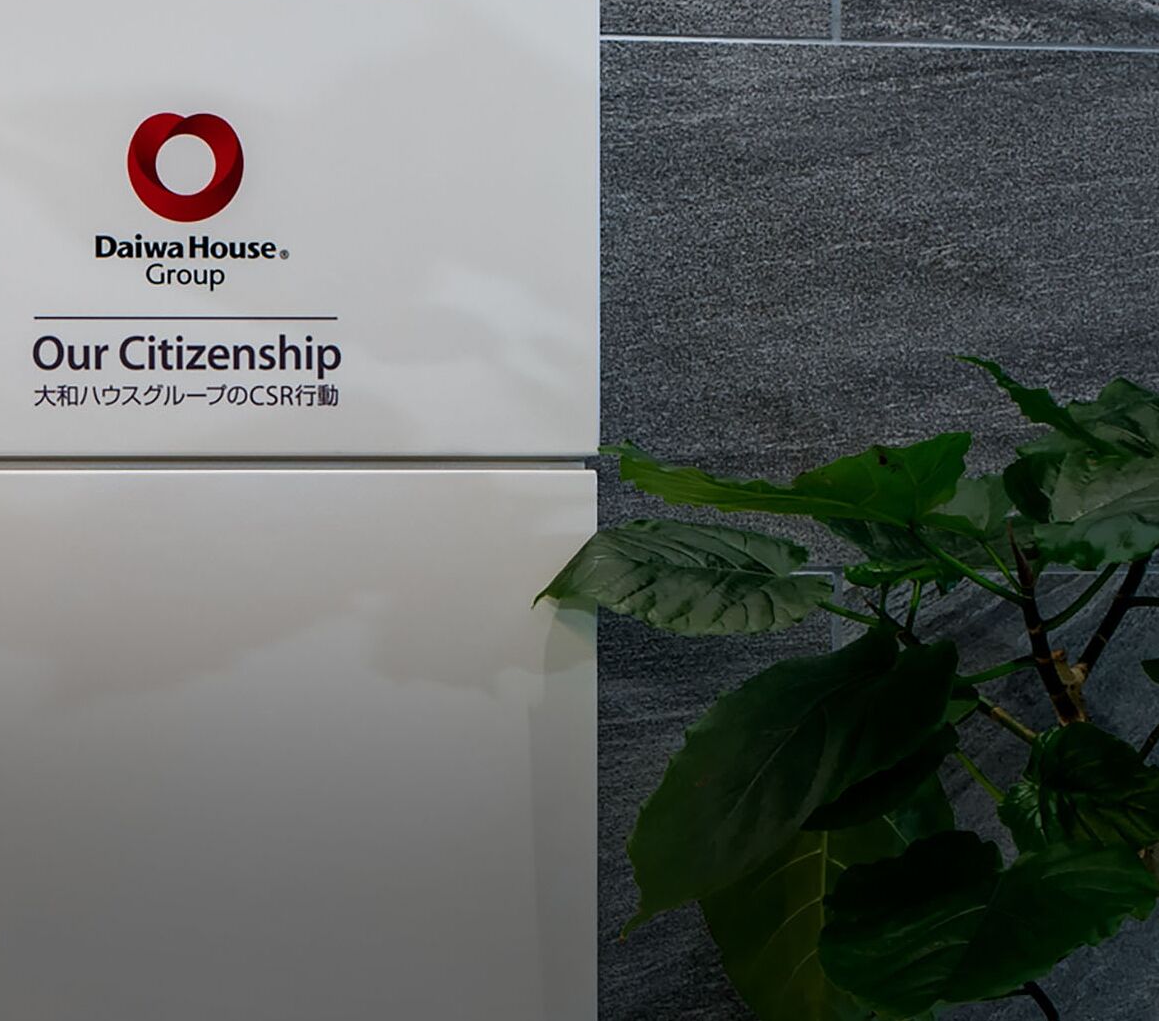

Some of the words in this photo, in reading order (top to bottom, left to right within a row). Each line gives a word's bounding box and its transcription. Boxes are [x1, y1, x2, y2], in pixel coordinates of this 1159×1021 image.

[95, 233, 183, 259] Daiwa
[145, 263, 225, 291] Group
[32, 335, 109, 371] Our
[119, 334, 342, 380] Citizenship
[33, 385, 339, 407] 大和ハウスグループのCSR行動
